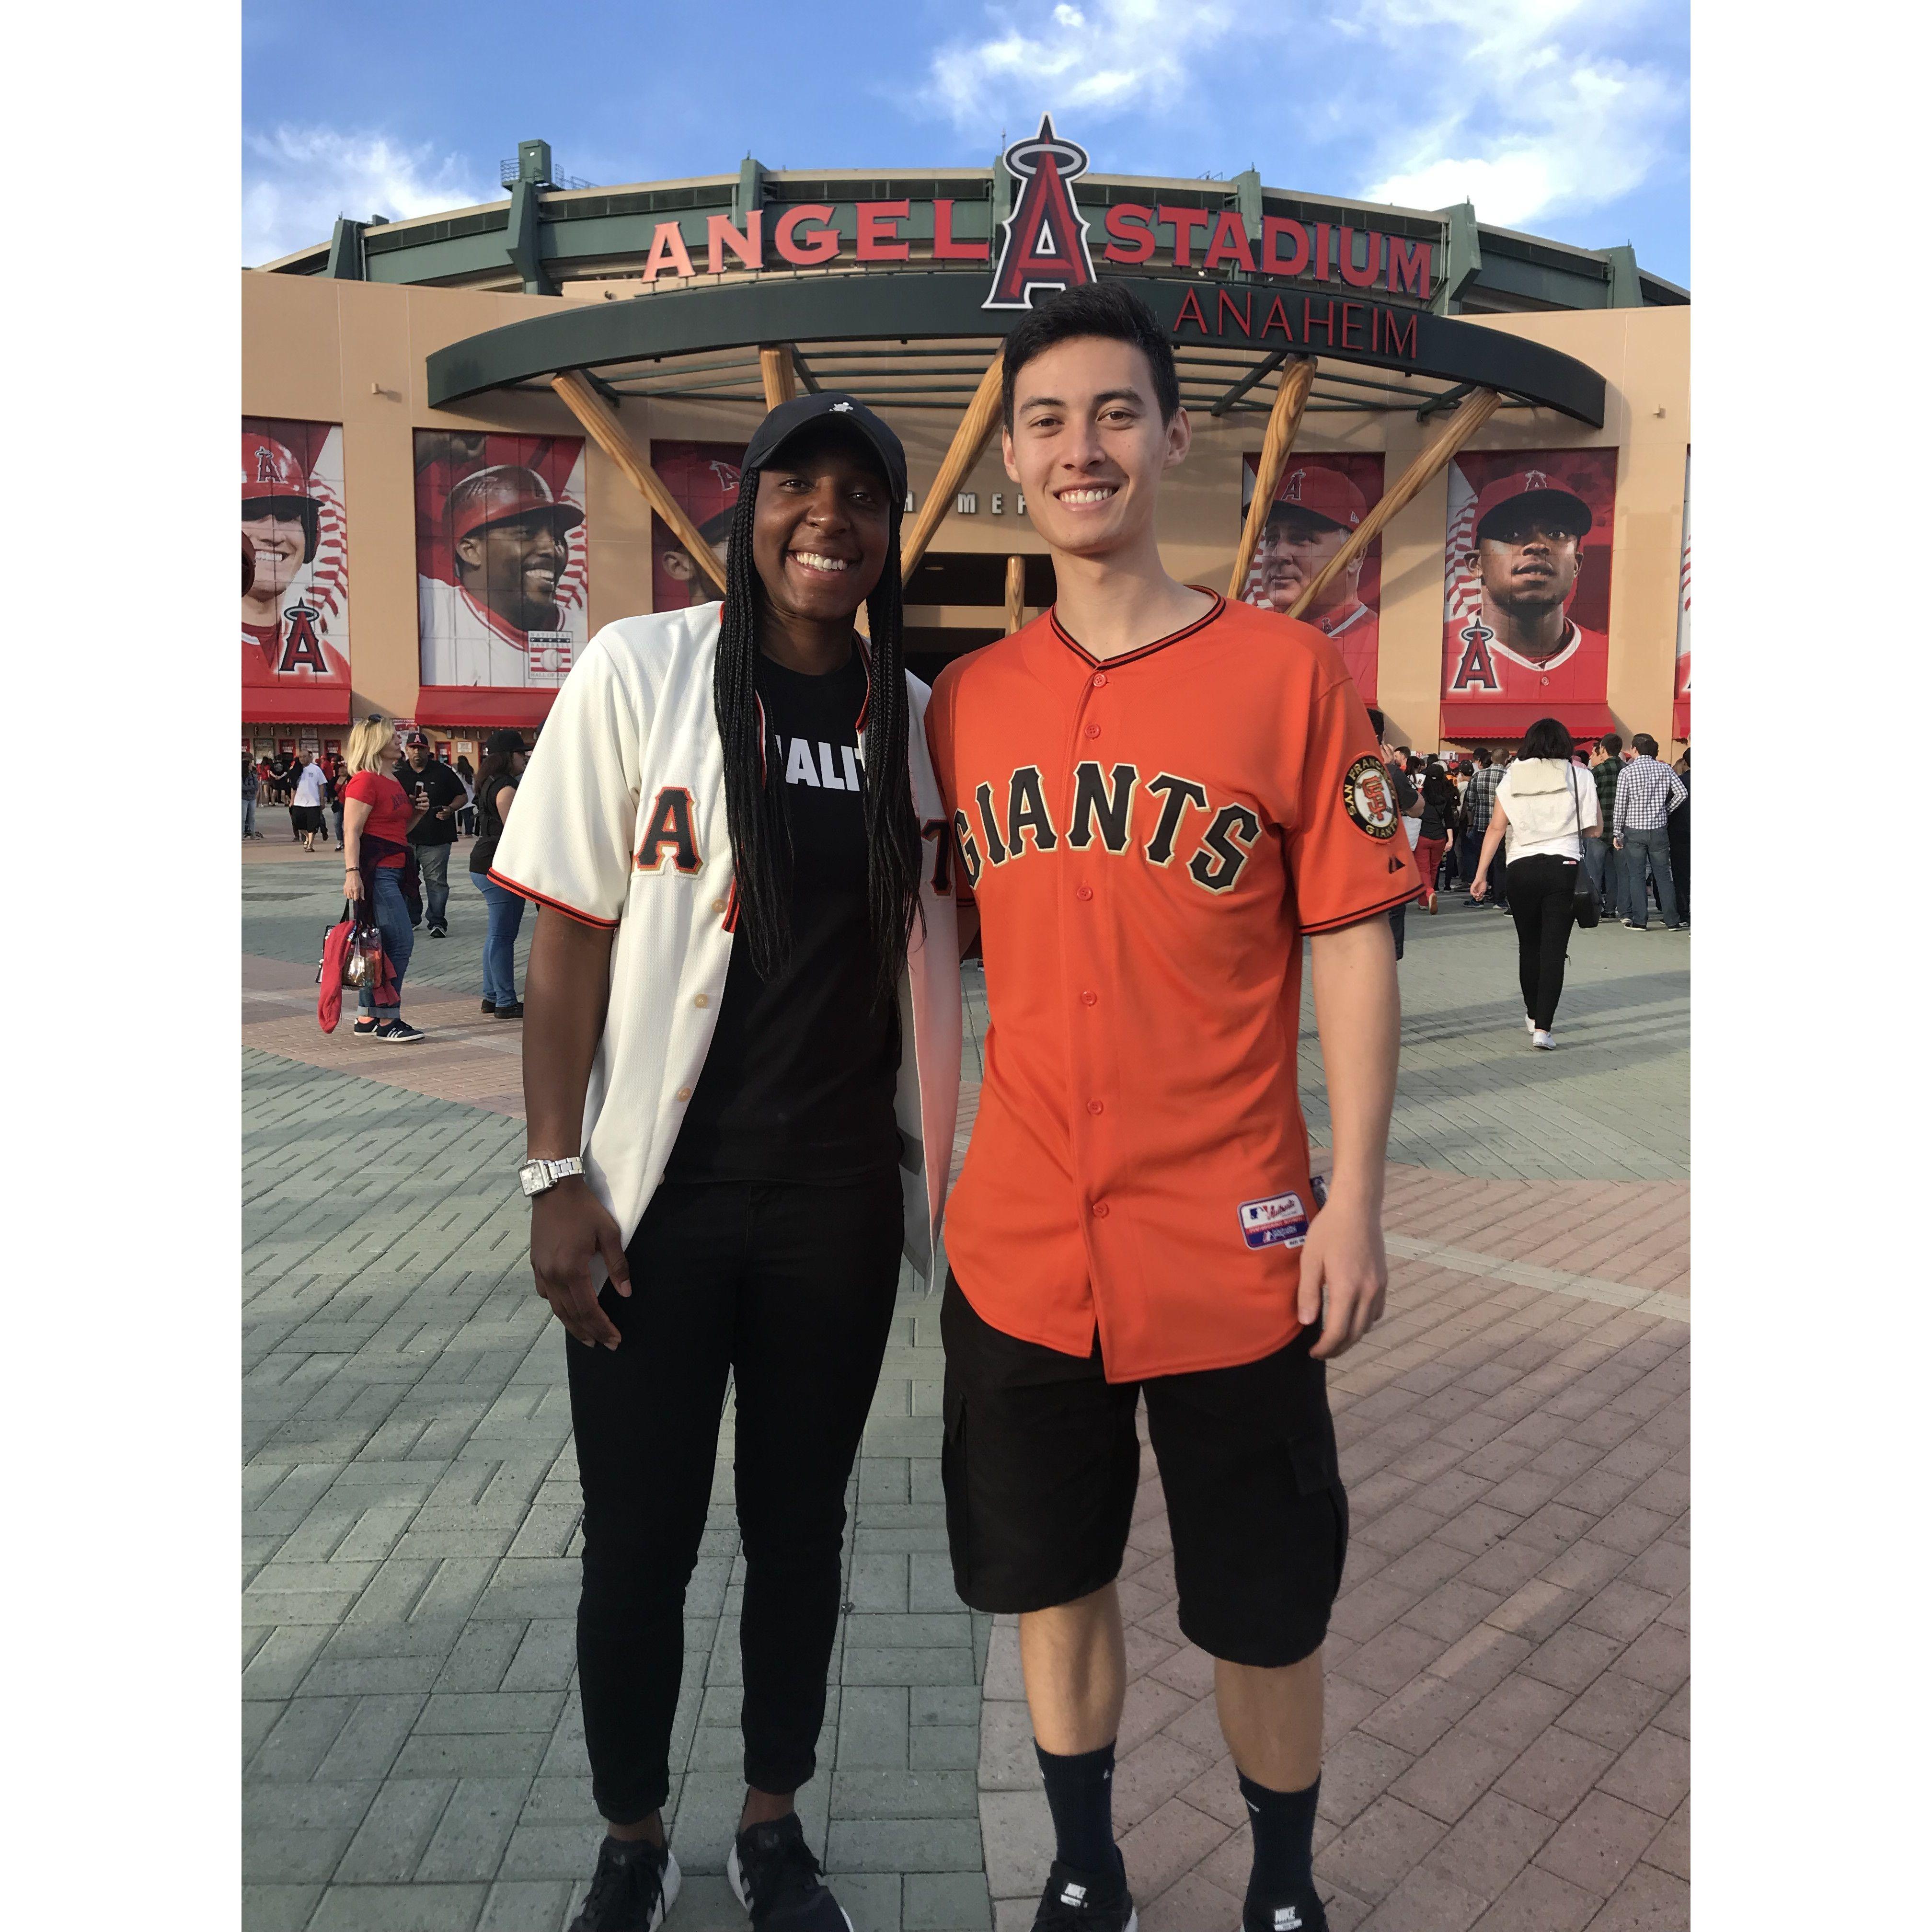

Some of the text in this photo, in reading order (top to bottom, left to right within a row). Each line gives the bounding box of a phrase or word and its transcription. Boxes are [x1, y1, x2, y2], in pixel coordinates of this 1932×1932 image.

[642, 198, 1433, 300] ANGEL STADIUM
[1173, 287, 1418, 359] ANAHEIM
[775, 735, 862, 791] ALI
[953, 760, 1262, 896] GIANTS
[1344, 784, 1357, 816] SAN
